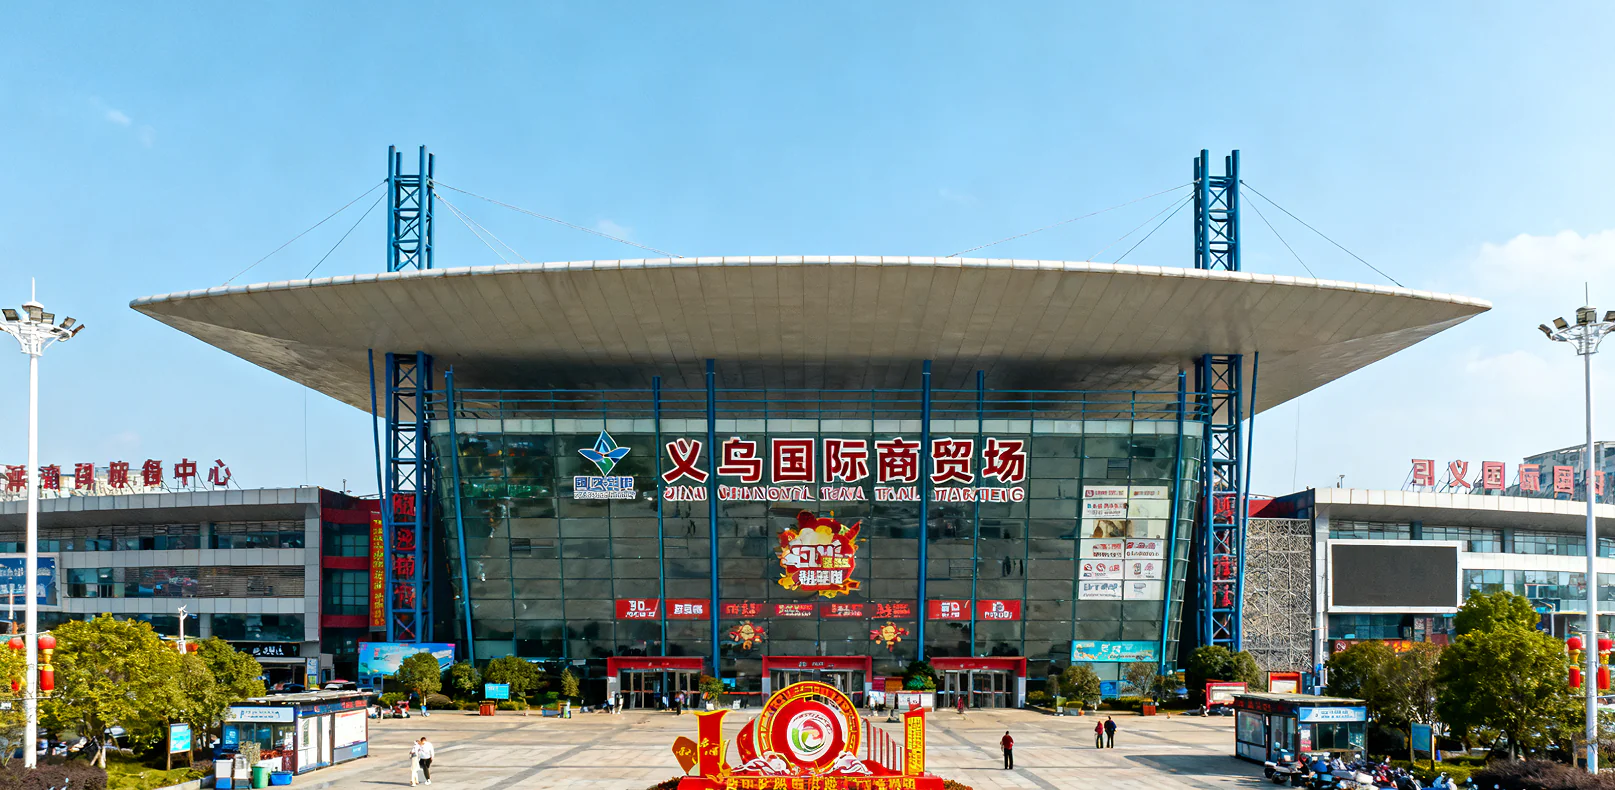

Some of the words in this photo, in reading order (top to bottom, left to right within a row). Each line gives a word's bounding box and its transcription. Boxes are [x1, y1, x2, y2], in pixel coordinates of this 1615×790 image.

[662, 436, 1027, 484] 义乌国际商贸场
